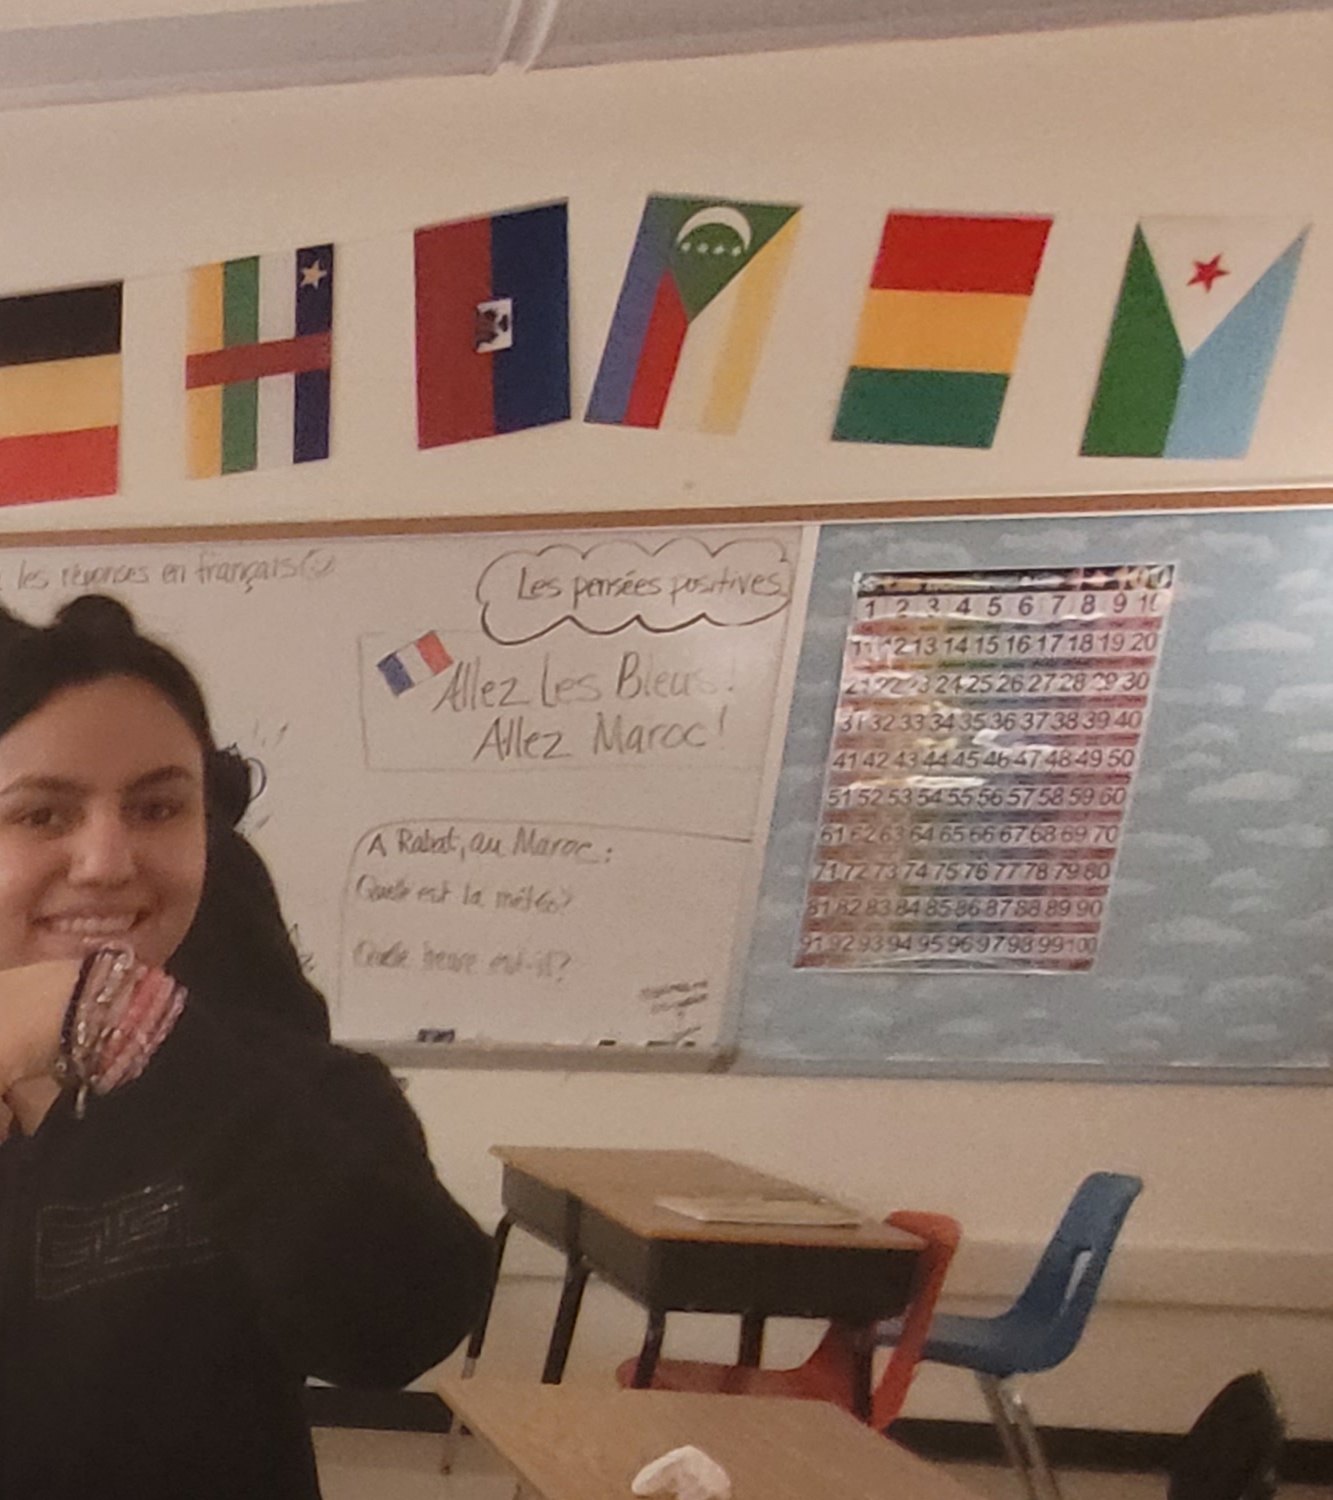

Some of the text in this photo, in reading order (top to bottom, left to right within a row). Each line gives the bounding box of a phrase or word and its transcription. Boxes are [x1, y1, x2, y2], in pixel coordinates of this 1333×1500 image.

[17, 559, 49, 590] les
[162, 562, 187, 584] en
[517, 566, 782, 611] Les pensées positives
[864, 594, 1125, 618] 1 2 4 5 6 7 8 9
[913, 632, 1156, 655] 13 14 15 16 17 18 19 20
[432, 655, 531, 714] Allez
[966, 675, 992, 692] 25
[997, 674, 1023, 691] 26
[1028, 673, 1054, 690] 27
[871, 710, 1140, 731] 32 37 38 39 40
[471, 704, 728, 763] Allez Maroc!
[834, 749, 1133, 769] 41 42 49 50
[1009, 788, 1093, 805] 57 58 59
[367, 832, 388, 858] A
[1002, 825, 1117, 842] 67 70
[905, 863, 928, 880] 74
[935, 863, 958, 880] 75
[1024, 862, 1048, 880] 78
[1054, 862, 1078, 880] 79
